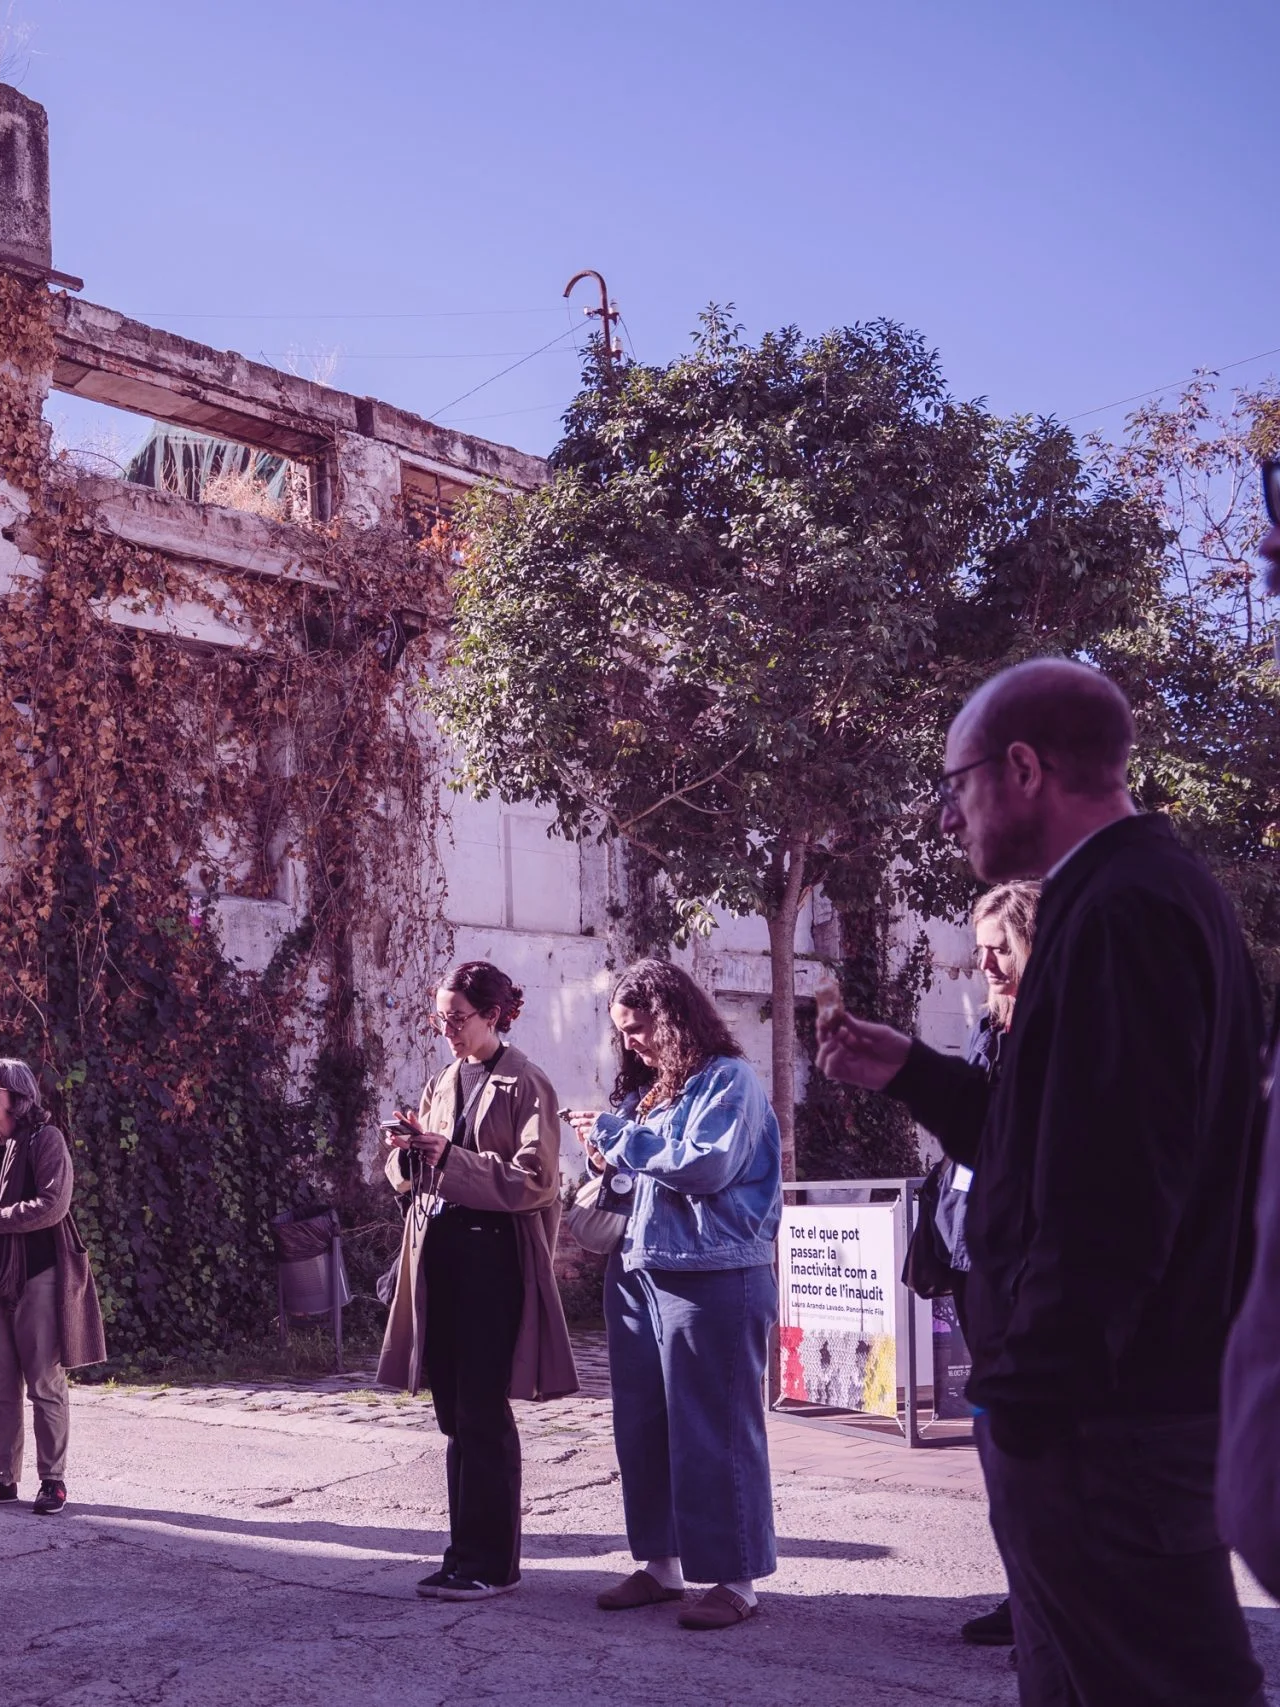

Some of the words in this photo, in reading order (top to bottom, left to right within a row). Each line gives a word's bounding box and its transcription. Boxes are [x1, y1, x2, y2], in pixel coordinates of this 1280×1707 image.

[790, 1226, 805, 1239] Tot
[808, 1226, 817, 1239] el
[819, 1229, 838, 1243] que
[841, 1228, 860, 1243] pot
[791, 1247, 825, 1261] passar:
[827, 1246, 837, 1260] la
[791, 1261, 842, 1278] inactivitat
[844, 1268, 868, 1280] com
[870, 1269, 877, 1280] a
[791, 1283, 822, 1296] motor
[825, 1283, 838, 1297] de
